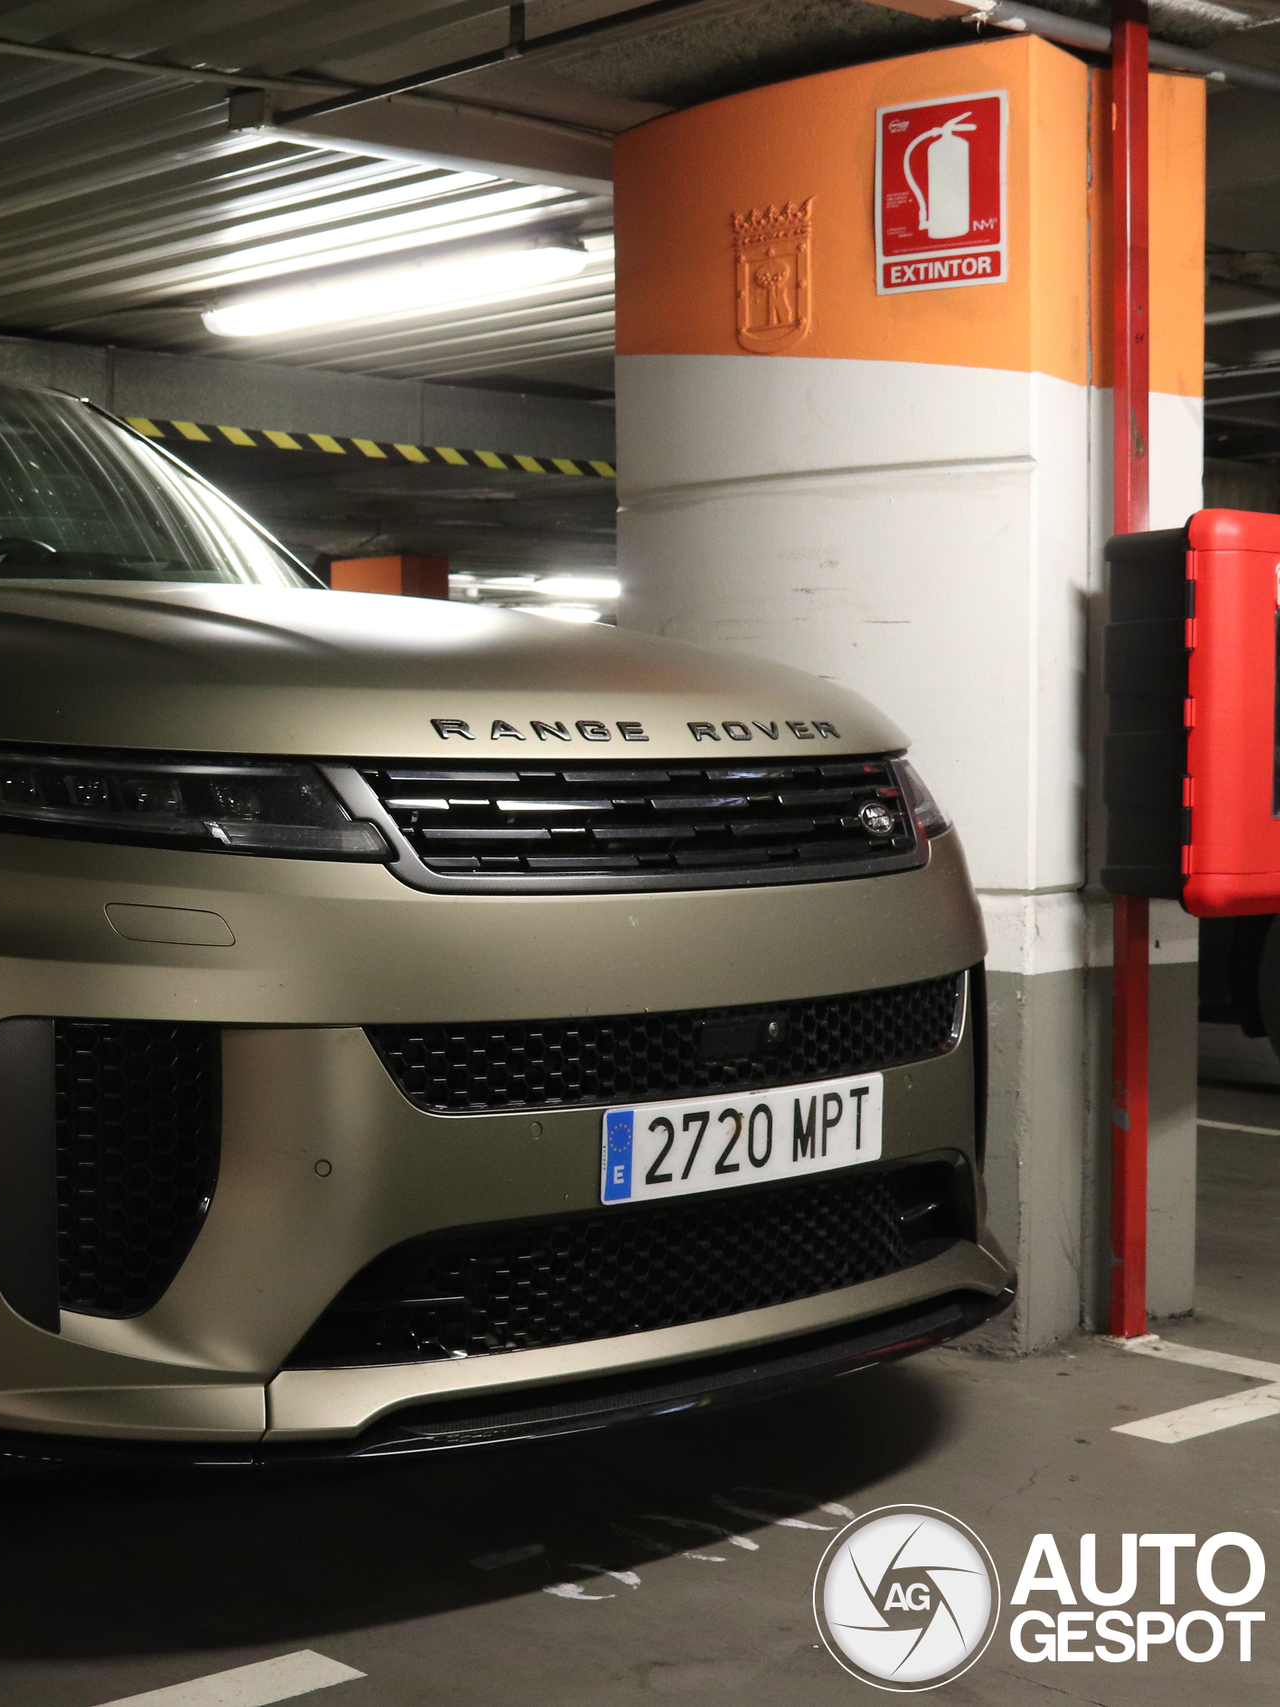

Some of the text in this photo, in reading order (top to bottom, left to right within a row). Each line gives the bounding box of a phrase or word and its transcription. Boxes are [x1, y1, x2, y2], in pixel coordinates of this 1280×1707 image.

[890, 255, 992, 284] EXTINTOR
[429, 718, 841, 742] RANGE ROVER
[644, 1086, 870, 1185] 2720 MPT
[613, 1164, 625, 1184] E
